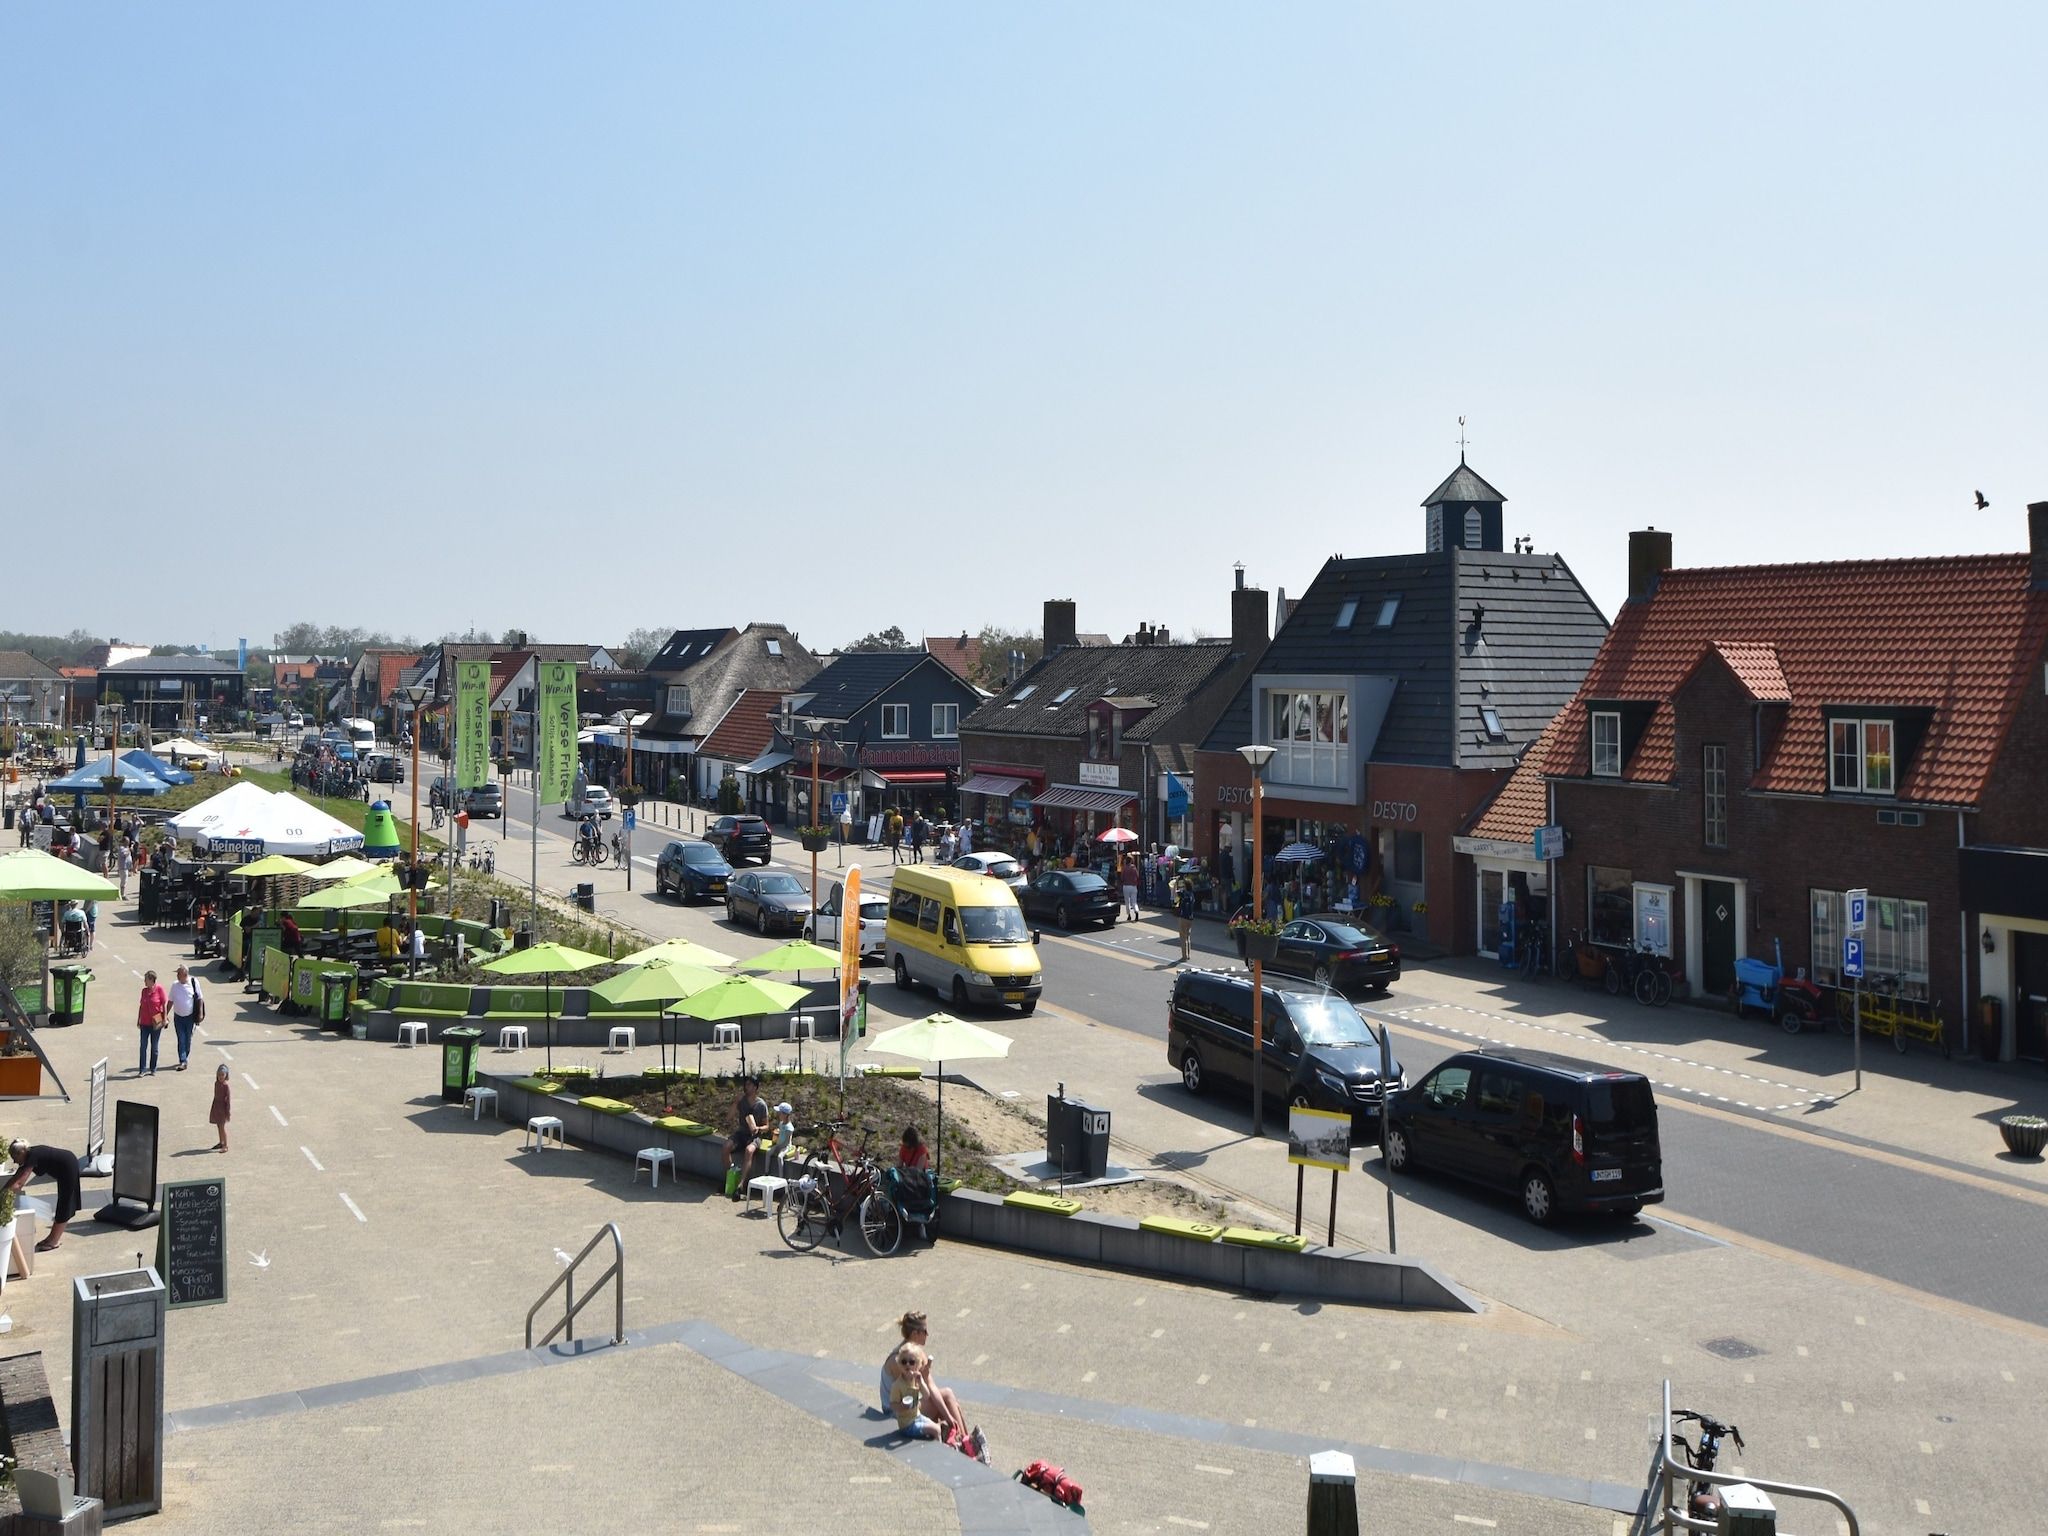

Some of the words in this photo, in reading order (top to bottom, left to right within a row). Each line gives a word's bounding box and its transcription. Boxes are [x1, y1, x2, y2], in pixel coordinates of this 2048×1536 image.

[474, 697, 484, 738] Verse
[560, 701, 571, 748] Verse
[474, 743, 484, 782] Frites
[560, 754, 571, 798] Frites
[1218, 786, 1252, 804] DESTO
[1373, 801, 1417, 822] DESTO
[211, 840, 262, 854] Heineken
[331, 838, 362, 853] Heineken
[1854, 902, 1862, 920] P
[1848, 942, 1858, 959] P
